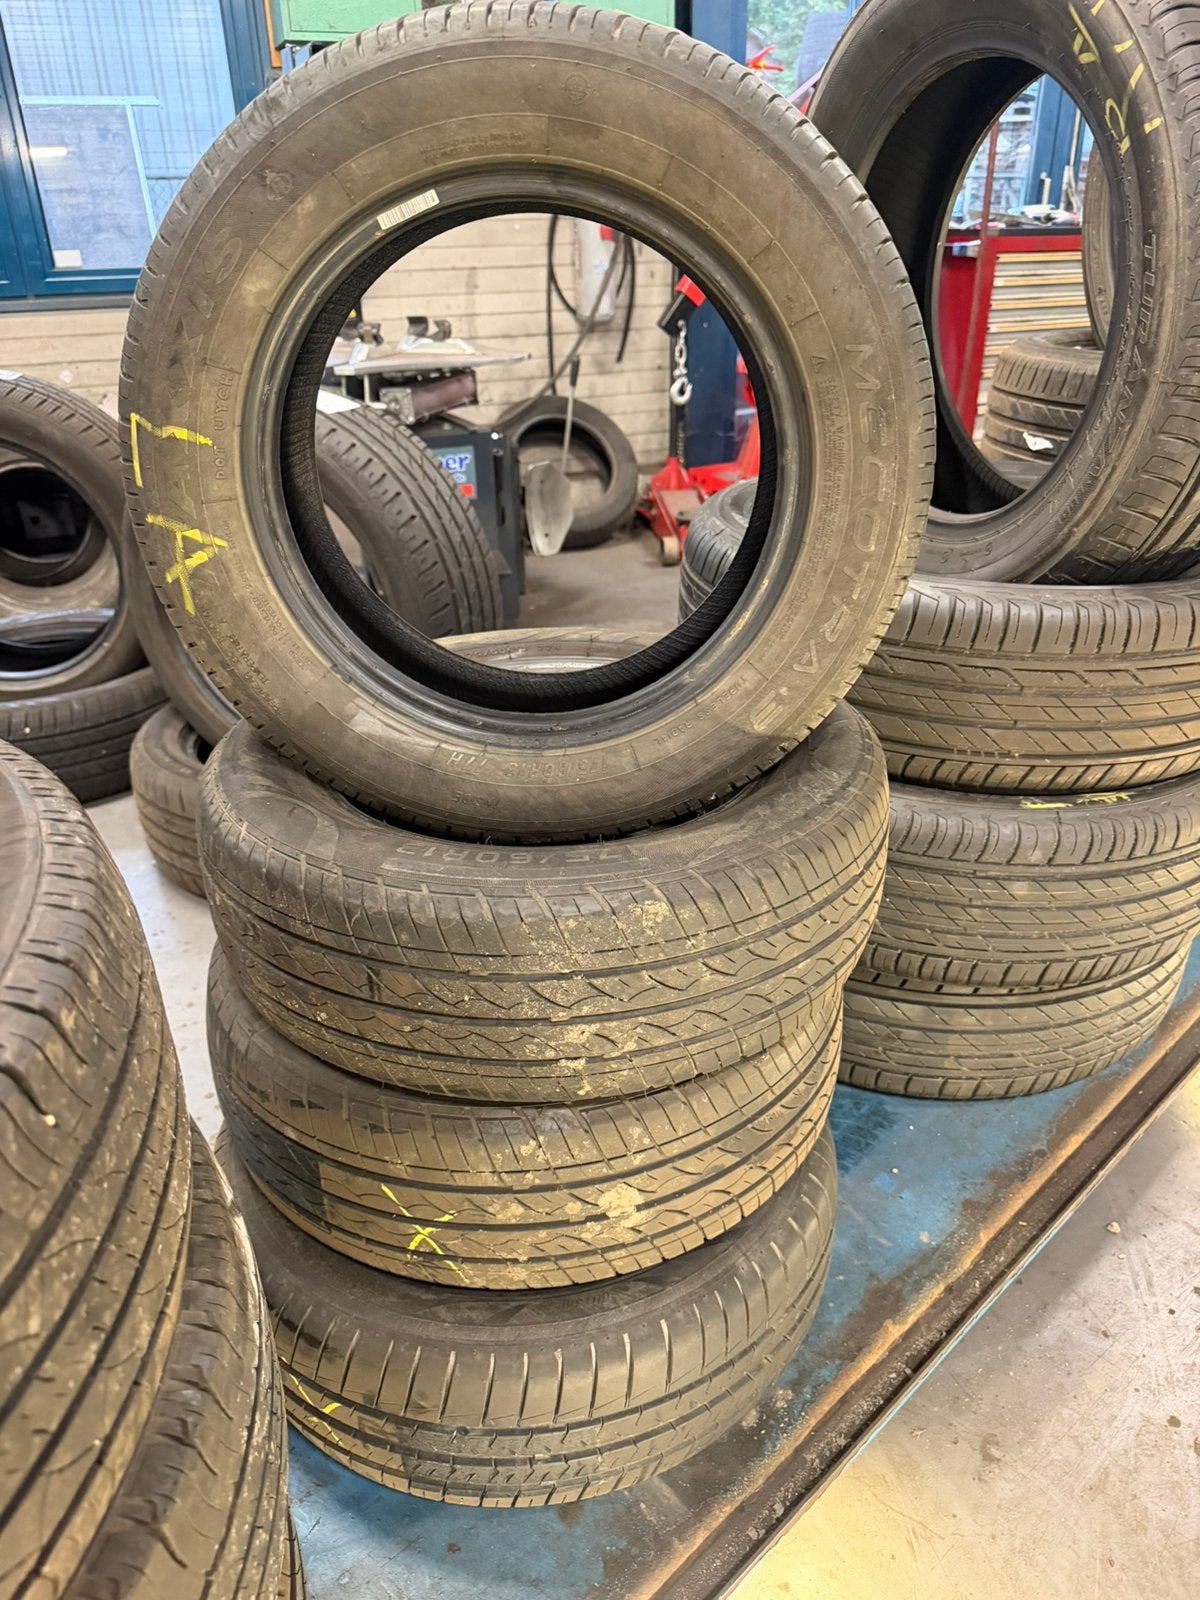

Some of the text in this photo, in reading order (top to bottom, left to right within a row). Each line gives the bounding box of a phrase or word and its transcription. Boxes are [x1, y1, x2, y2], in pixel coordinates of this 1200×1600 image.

[213, 446, 227, 481] DOT
[793, 343, 888, 675] MECOTRA
[448, 750, 488, 774] 77H
